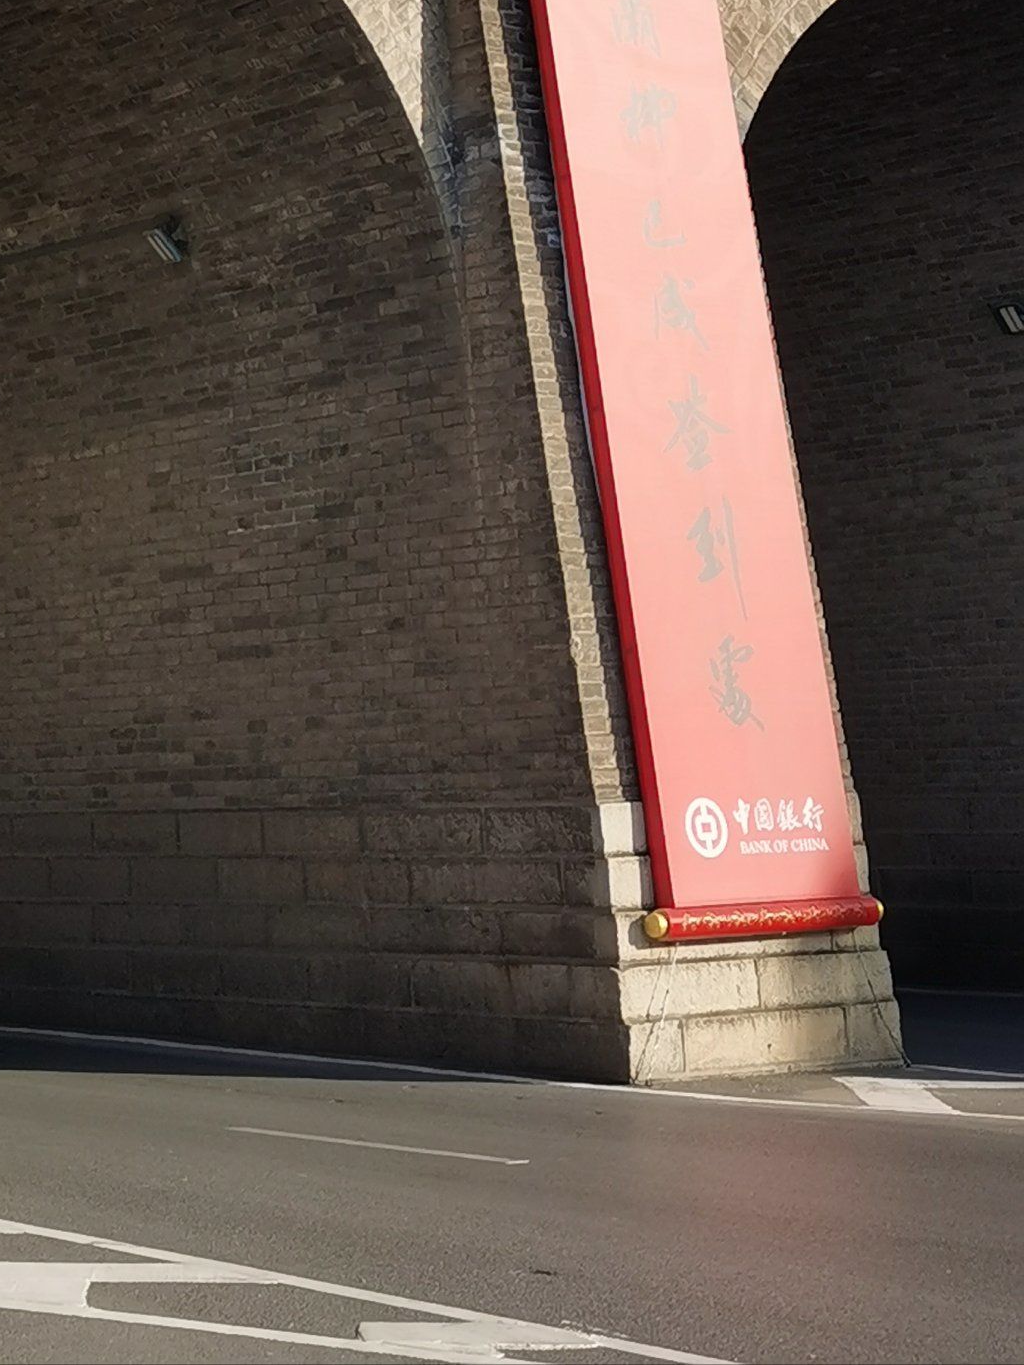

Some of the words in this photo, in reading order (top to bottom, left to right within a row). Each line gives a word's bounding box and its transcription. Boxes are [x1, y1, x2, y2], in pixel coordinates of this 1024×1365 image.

[739, 839, 773, 855] BANK
[773, 838, 790, 853] OF
[791, 836, 830, 852] CHINA
